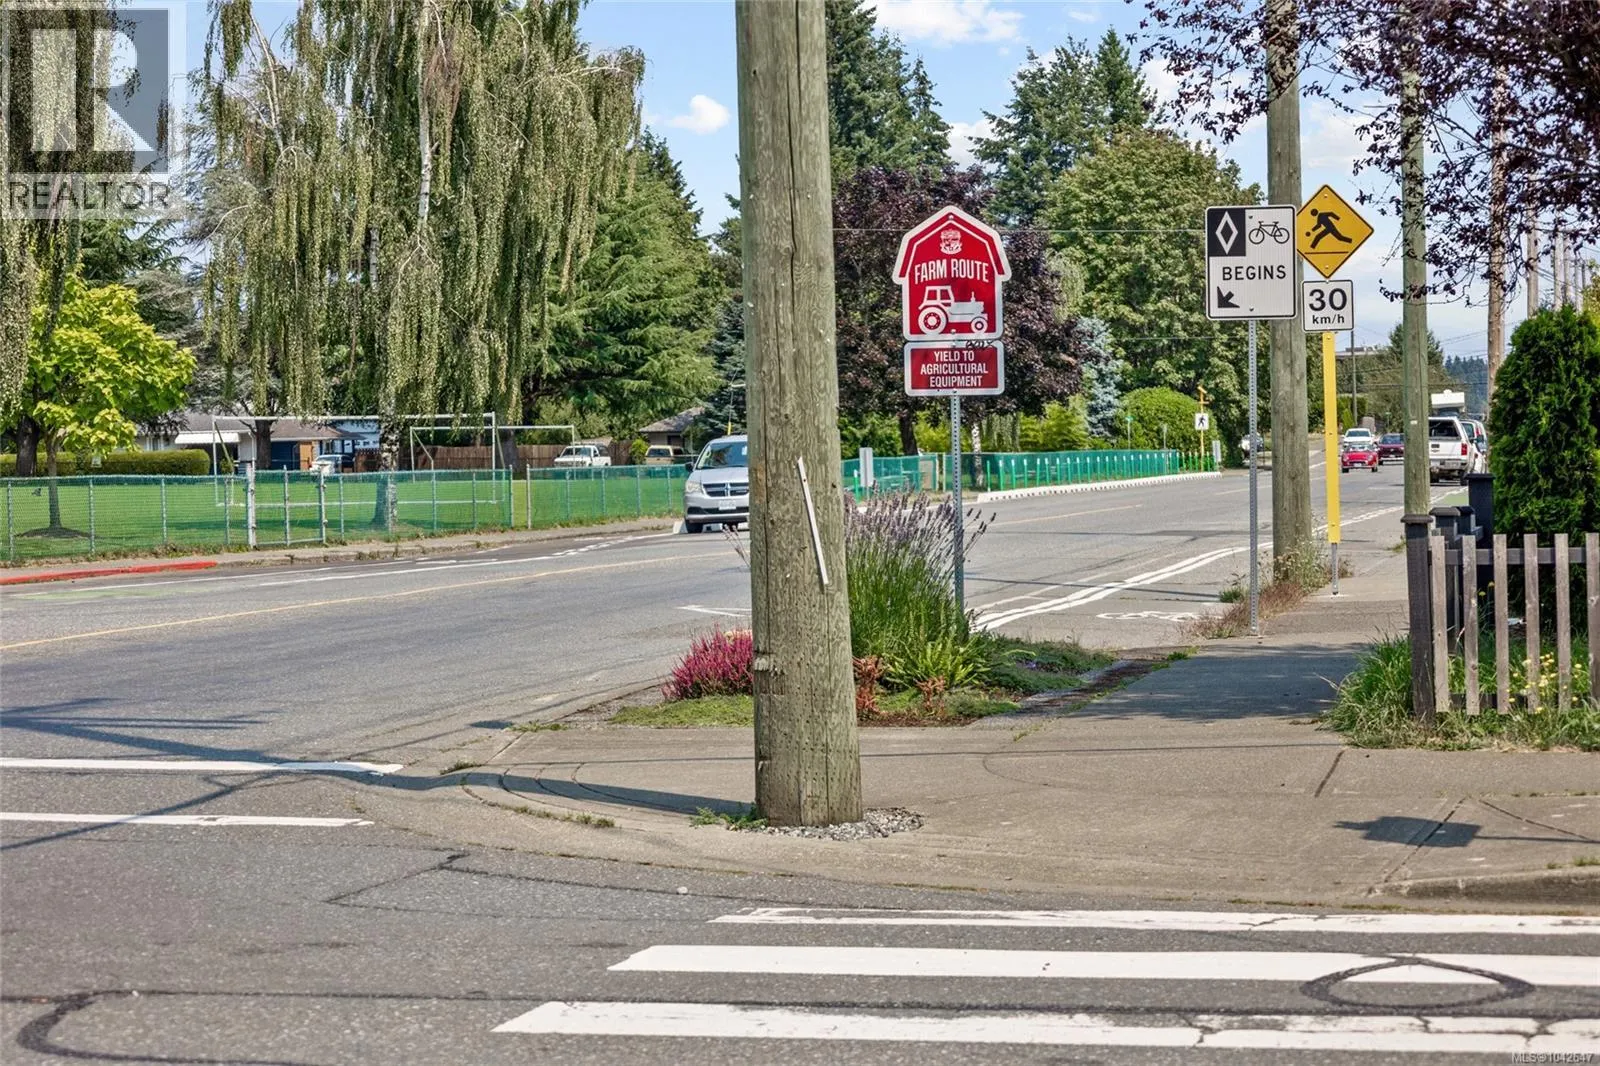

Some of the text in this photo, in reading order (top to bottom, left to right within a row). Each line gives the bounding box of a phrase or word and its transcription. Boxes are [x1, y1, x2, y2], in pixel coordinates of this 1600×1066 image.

[914, 258, 989, 285] FARM ROUTE
[1222, 265, 1286, 281] BEGINS
[1308, 288, 1347, 311] 30
[1312, 314, 1345, 325] km/h
[934, 350, 975, 362] YIELD TO
[920, 363, 988, 375] AGRICULTURAL
[929, 376, 983, 388] EQUIPMENT
